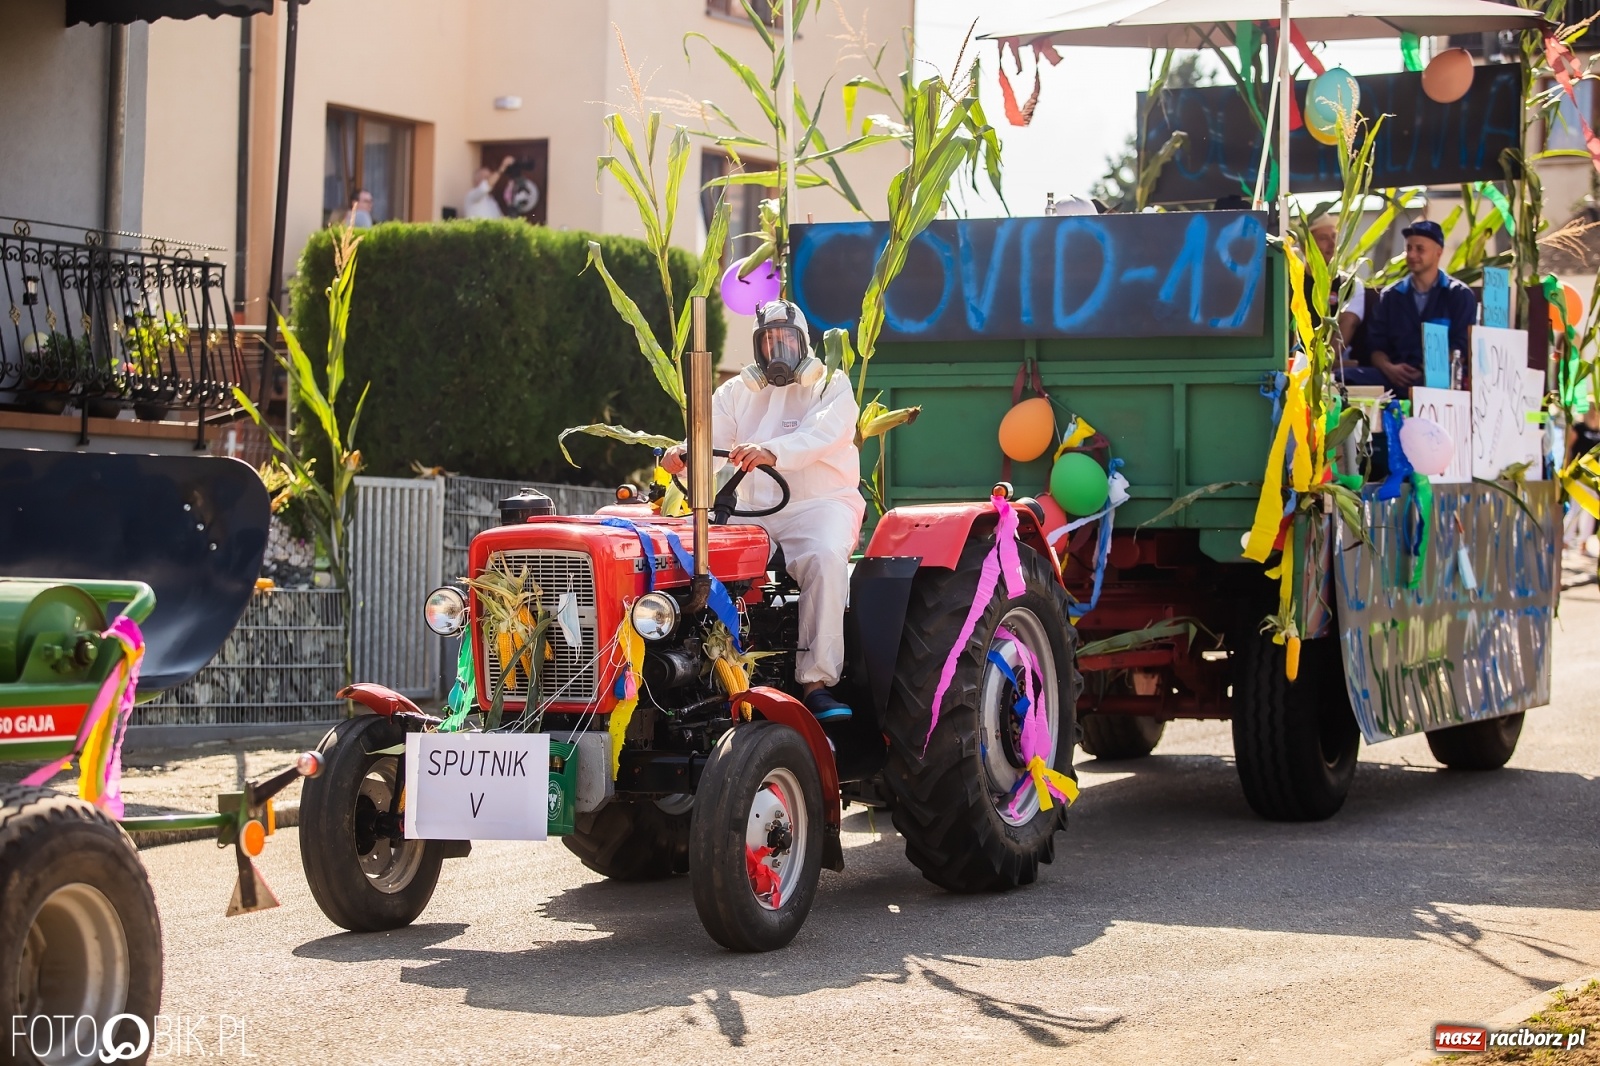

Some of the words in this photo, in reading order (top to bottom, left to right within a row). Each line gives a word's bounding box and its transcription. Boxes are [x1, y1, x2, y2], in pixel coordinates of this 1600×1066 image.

[794, 212, 1267, 333] COVID-19
[14, 714, 56, 733] GAJA
[427, 749, 529, 777] SPUTNIK
[470, 792, 485, 819] V
